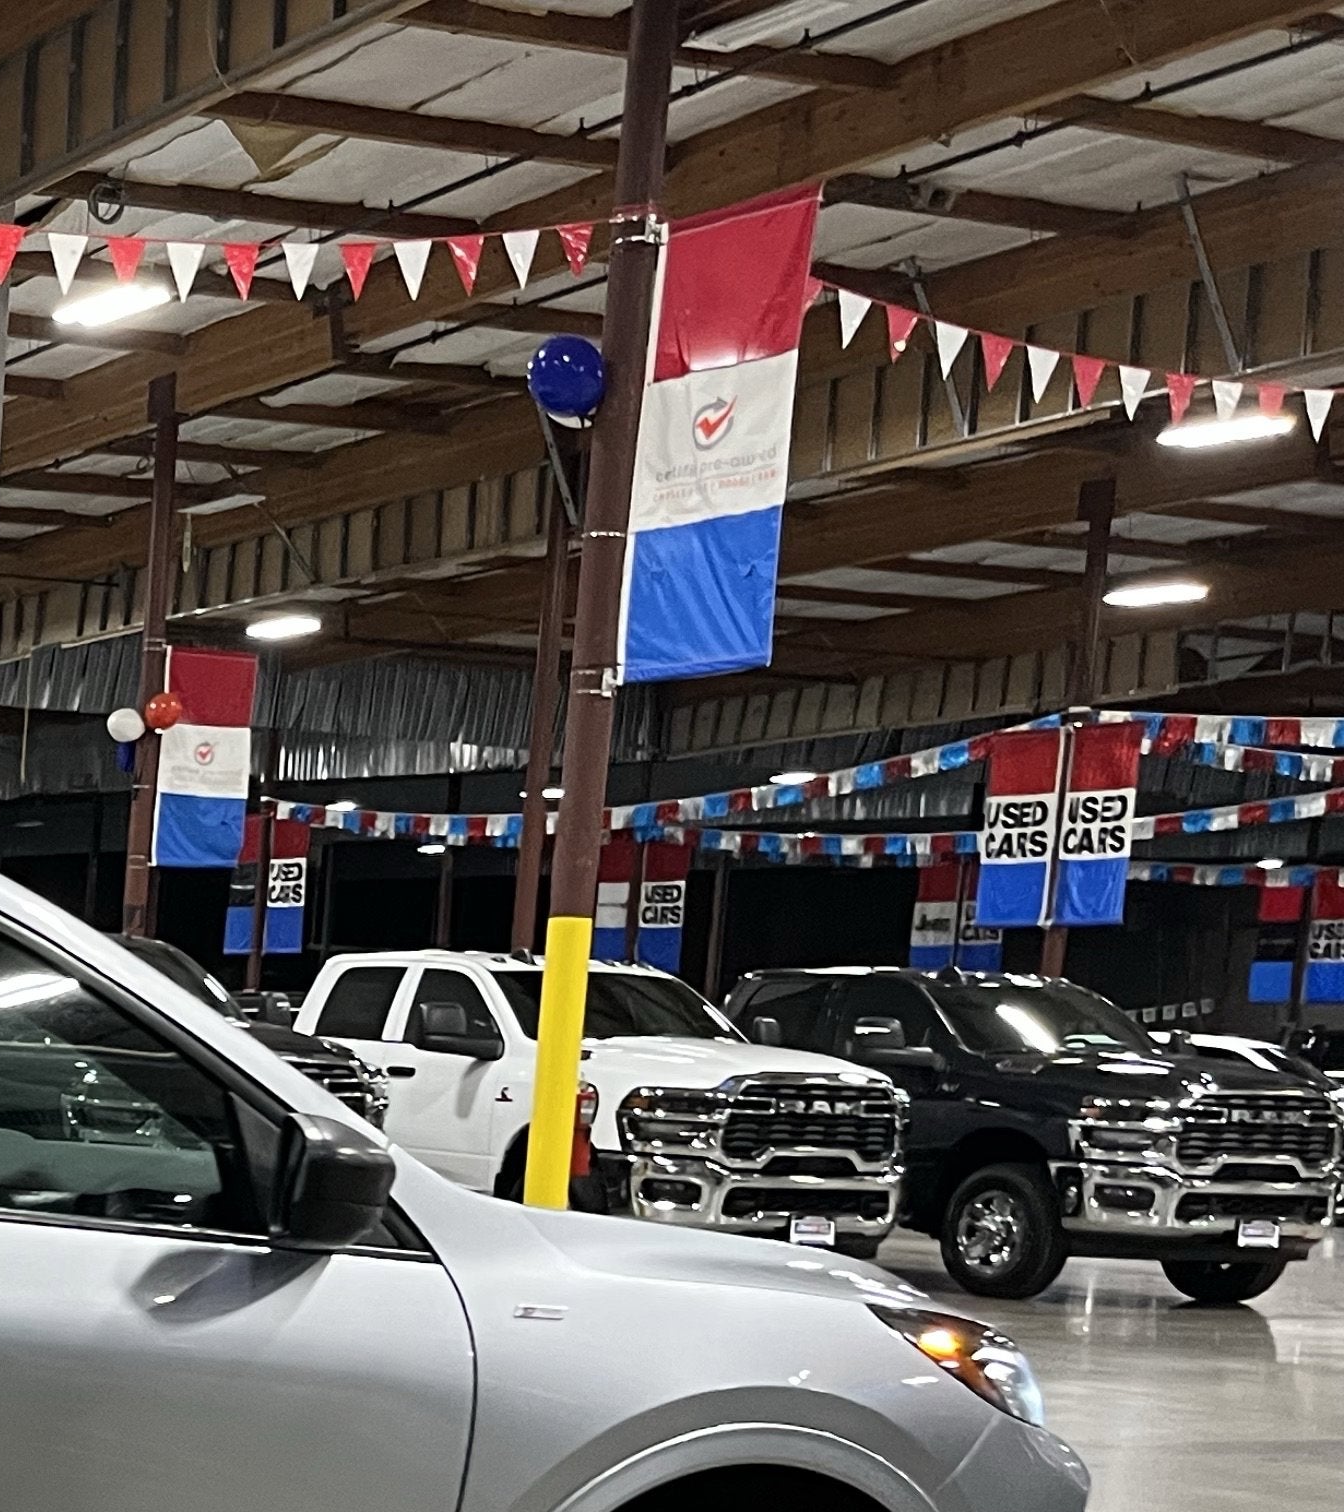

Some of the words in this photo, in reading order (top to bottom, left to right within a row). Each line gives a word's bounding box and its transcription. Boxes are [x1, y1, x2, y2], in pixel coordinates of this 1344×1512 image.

[987, 800, 1049, 829] USED
[1067, 795, 1128, 824] USED
[985, 830, 1048, 859] CARS
[1063, 825, 1126, 854] CARS
[779, 1100, 864, 1115] RAM
